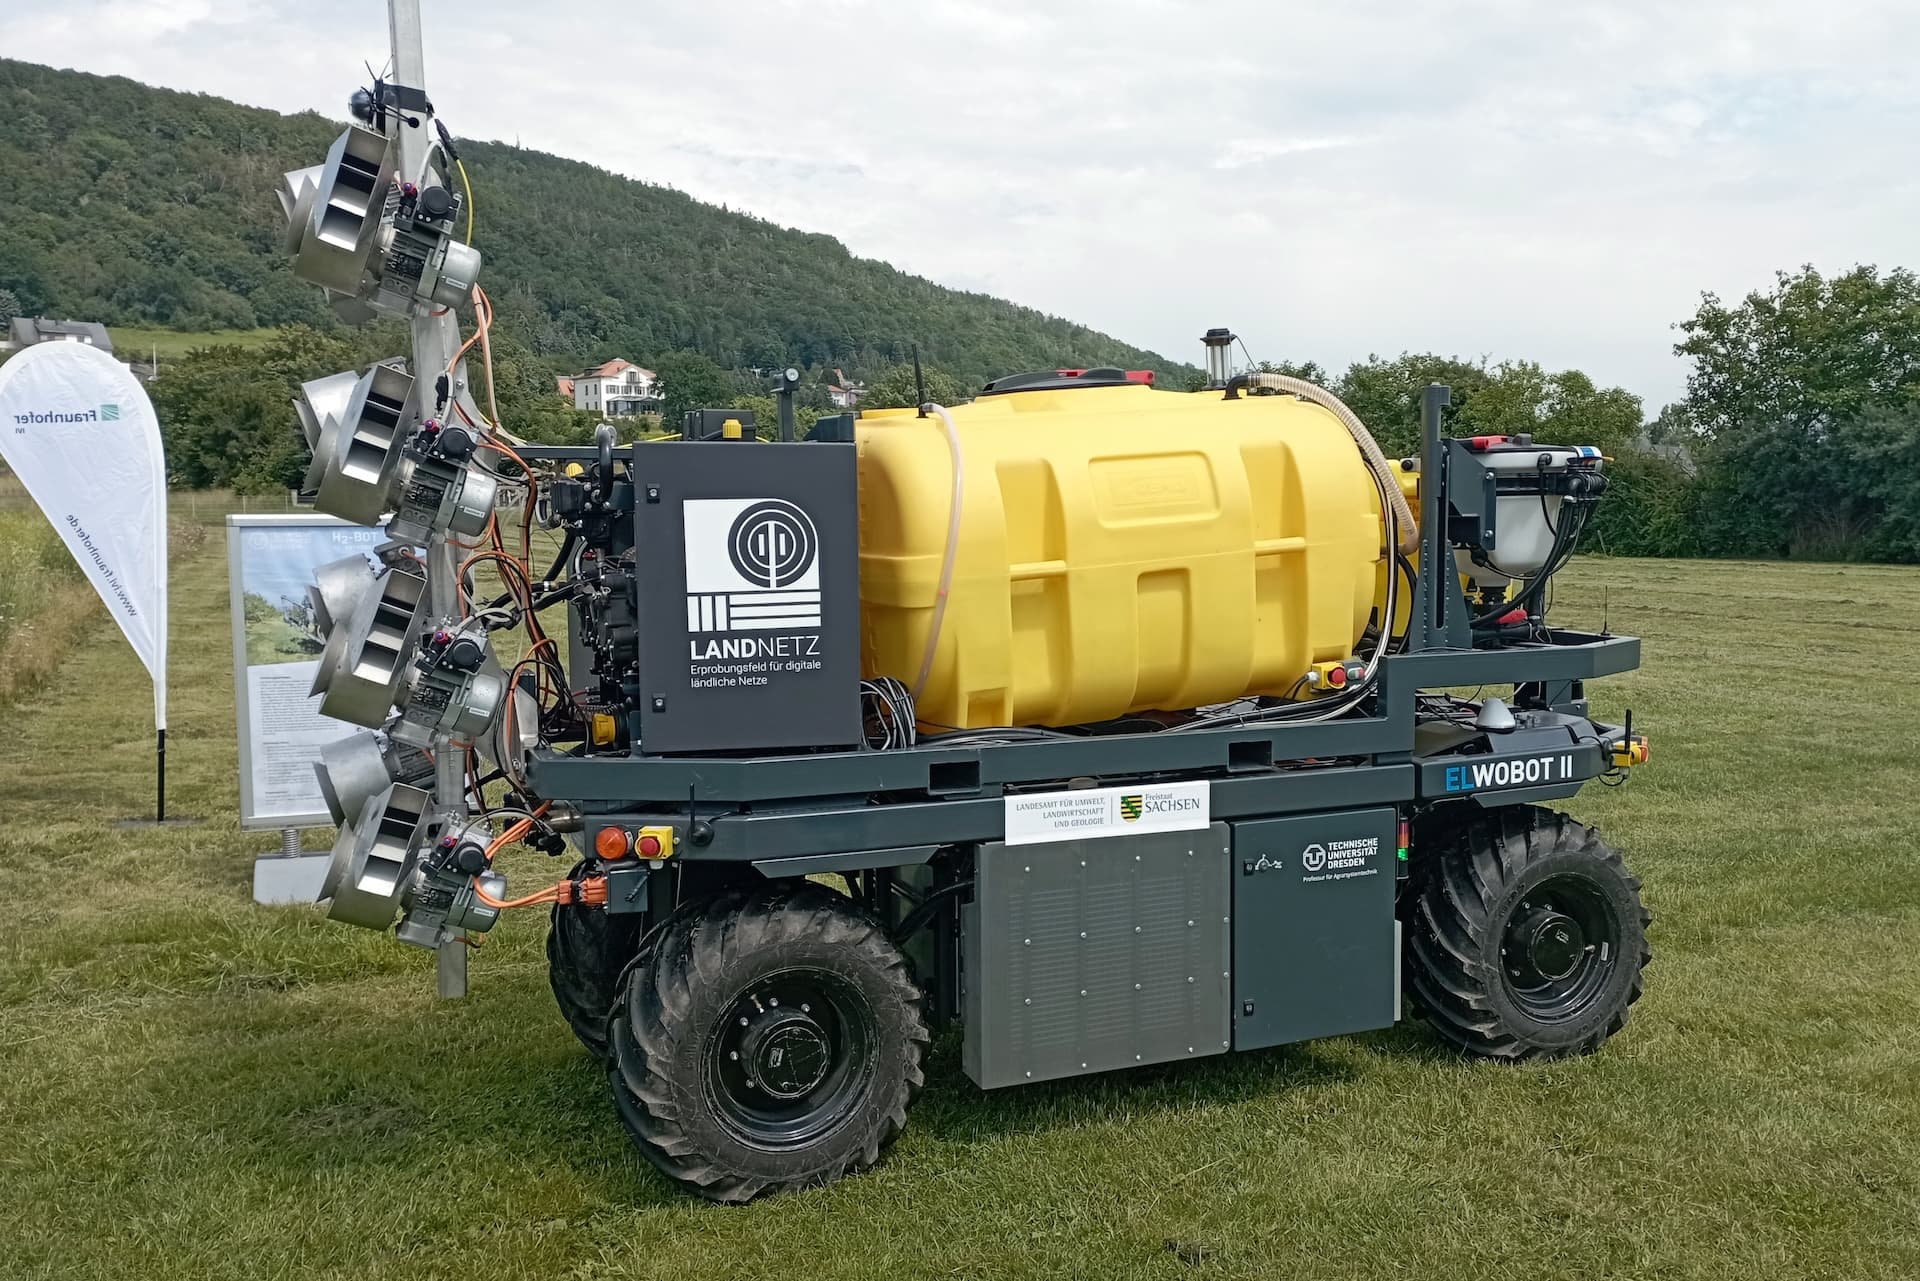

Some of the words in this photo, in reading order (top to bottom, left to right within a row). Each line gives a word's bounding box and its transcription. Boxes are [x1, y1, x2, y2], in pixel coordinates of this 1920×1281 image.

[690, 635, 821, 660] LANDNETZ
[690, 662, 767, 676] Erprobungsfeld
[769, 661, 783, 671] für
[785, 660, 821, 672] digitale
[691, 677, 736, 688] ländliche
[738, 676, 768, 686] Netze
[1446, 757, 1554, 792] ELWOBOT
[1560, 755, 1573, 778] II
[1145, 793, 1173, 801] Freistaat
[1016, 801, 1058, 811] LANDESAMT
[1059, 799, 1073, 807] FÜR
[1074, 797, 1105, 806] UMWELT,
[1145, 799, 1200, 813] SACHSEN
[1043, 807, 1105, 819] LANDWIRTSCHAFT
[1070, 817, 1105, 827] GEOLOGIE
[1328, 837, 1378, 850] TECHNISCHE
[1328, 847, 1378, 860] UNIVERSITÄT
[1328, 858, 1365, 869] DRESDEN
